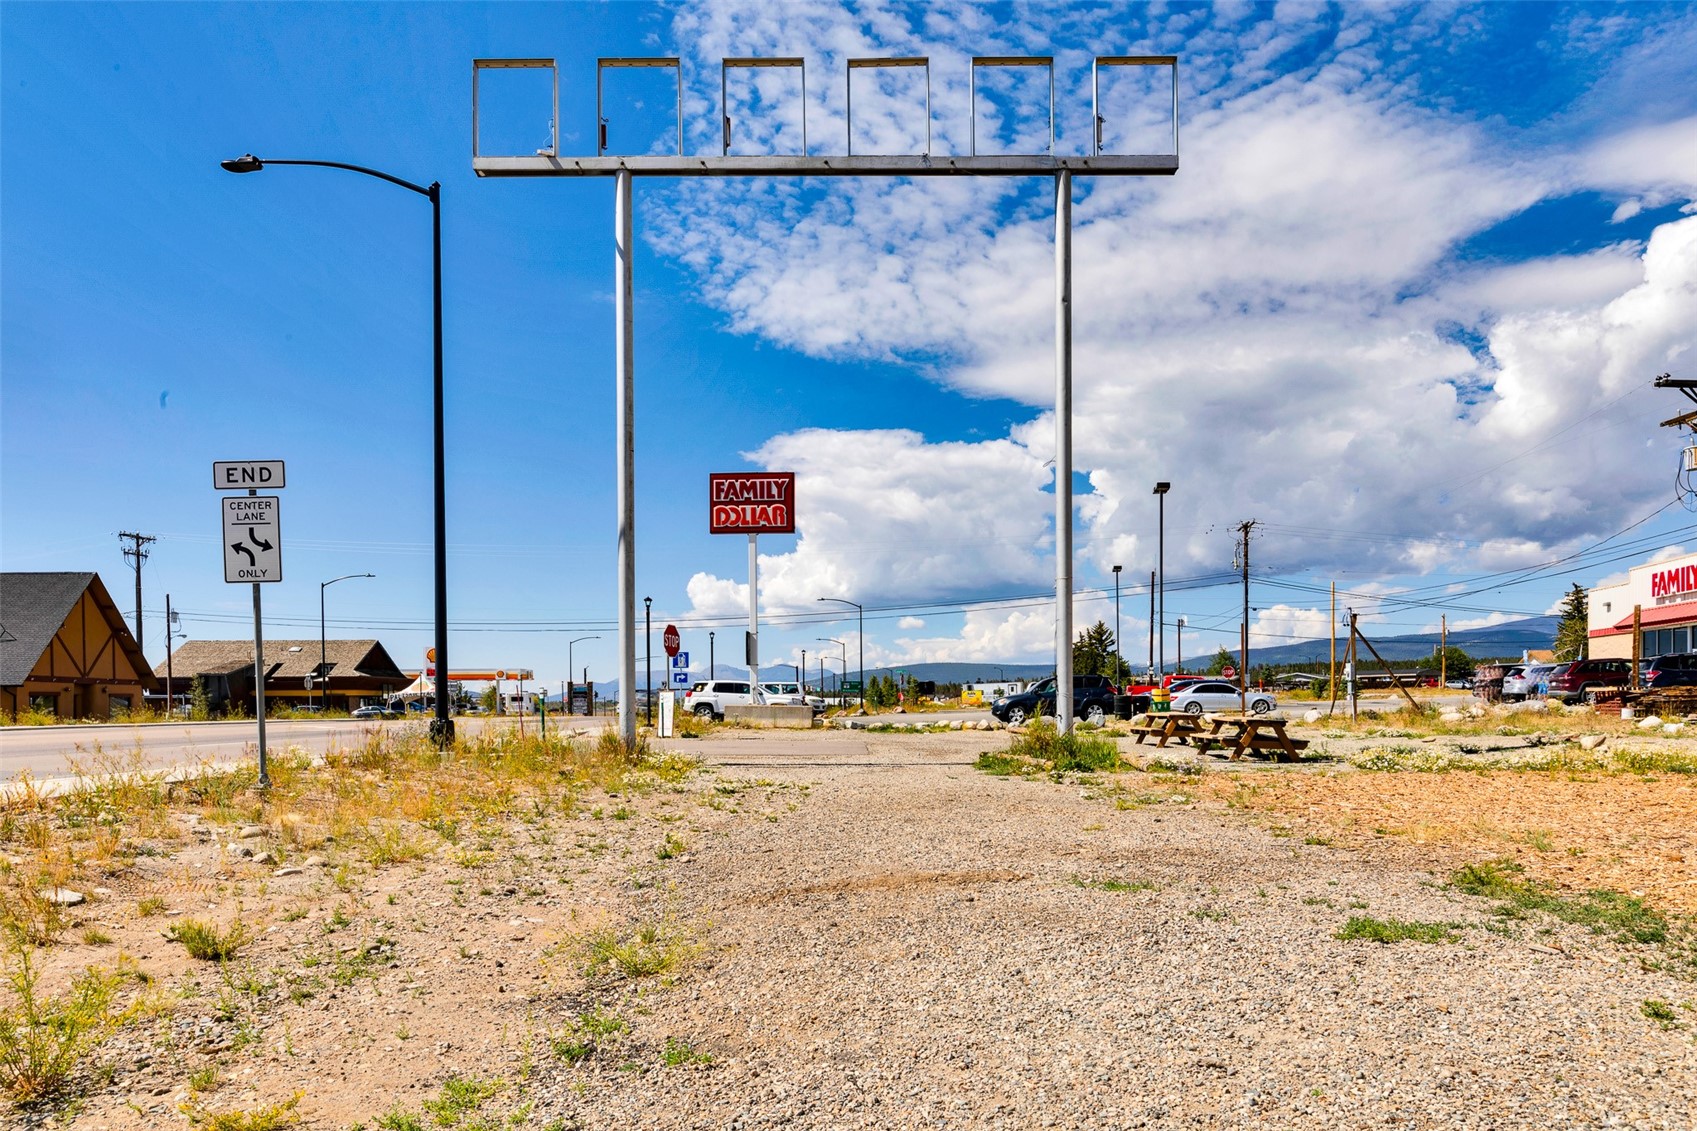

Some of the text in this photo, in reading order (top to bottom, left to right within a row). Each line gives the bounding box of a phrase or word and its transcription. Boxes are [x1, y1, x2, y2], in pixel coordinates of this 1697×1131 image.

[226, 467, 272, 483] END
[713, 478, 790, 502] FAMILY
[229, 501, 272, 511] CENTER
[236, 512, 266, 521] LANE
[713, 503, 787, 527] DOLLAR
[238, 569, 268, 578] ONLY
[664, 634, 679, 648] STOP
